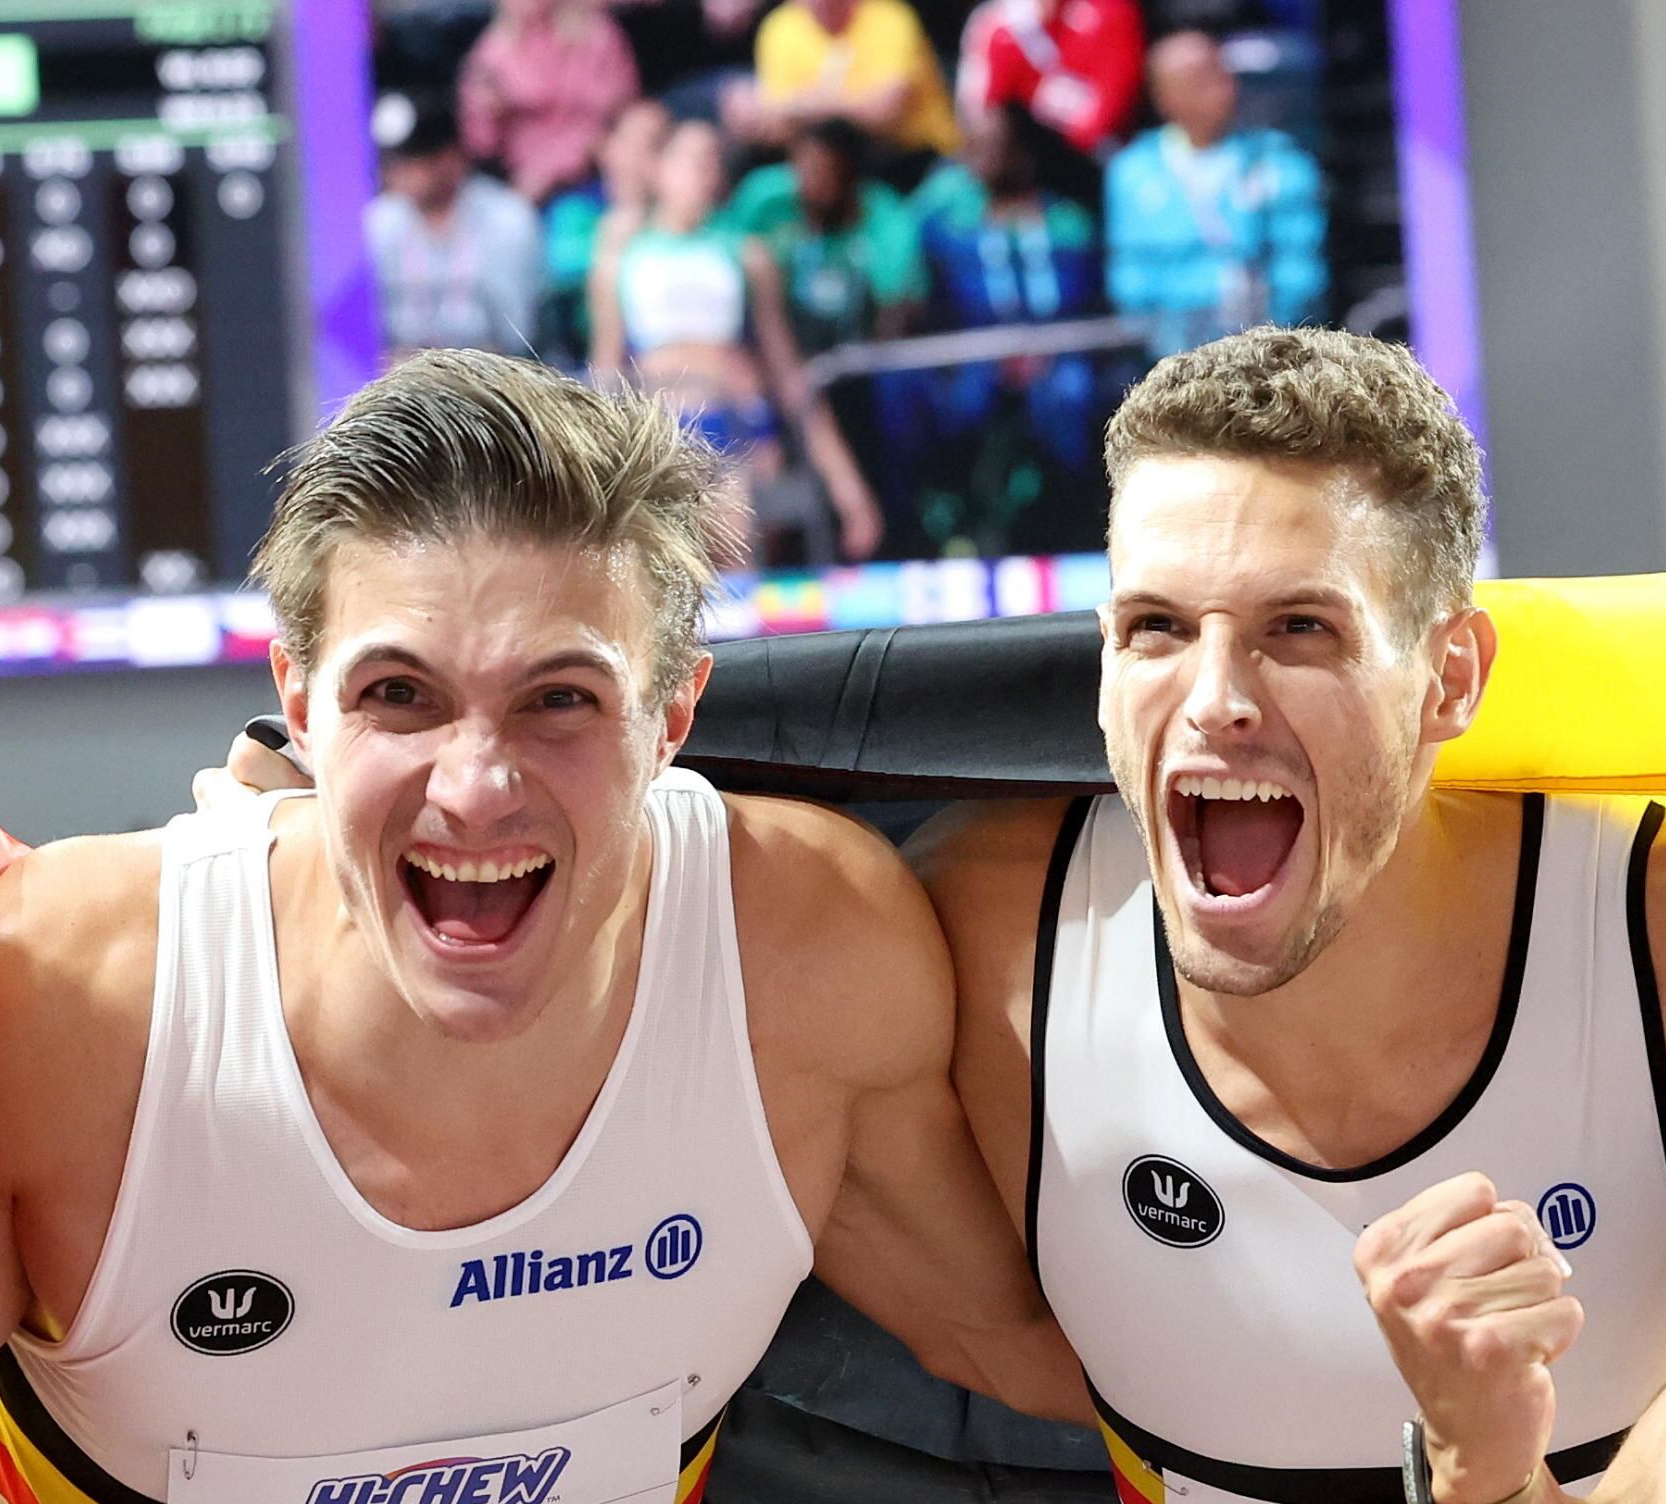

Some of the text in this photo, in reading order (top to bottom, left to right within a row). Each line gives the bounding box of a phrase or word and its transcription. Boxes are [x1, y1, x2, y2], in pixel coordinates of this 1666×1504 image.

[1138, 1201, 1207, 1234] vermarc
[450, 1243, 633, 1308] Allianz
[189, 1317, 272, 1339] vermarc
